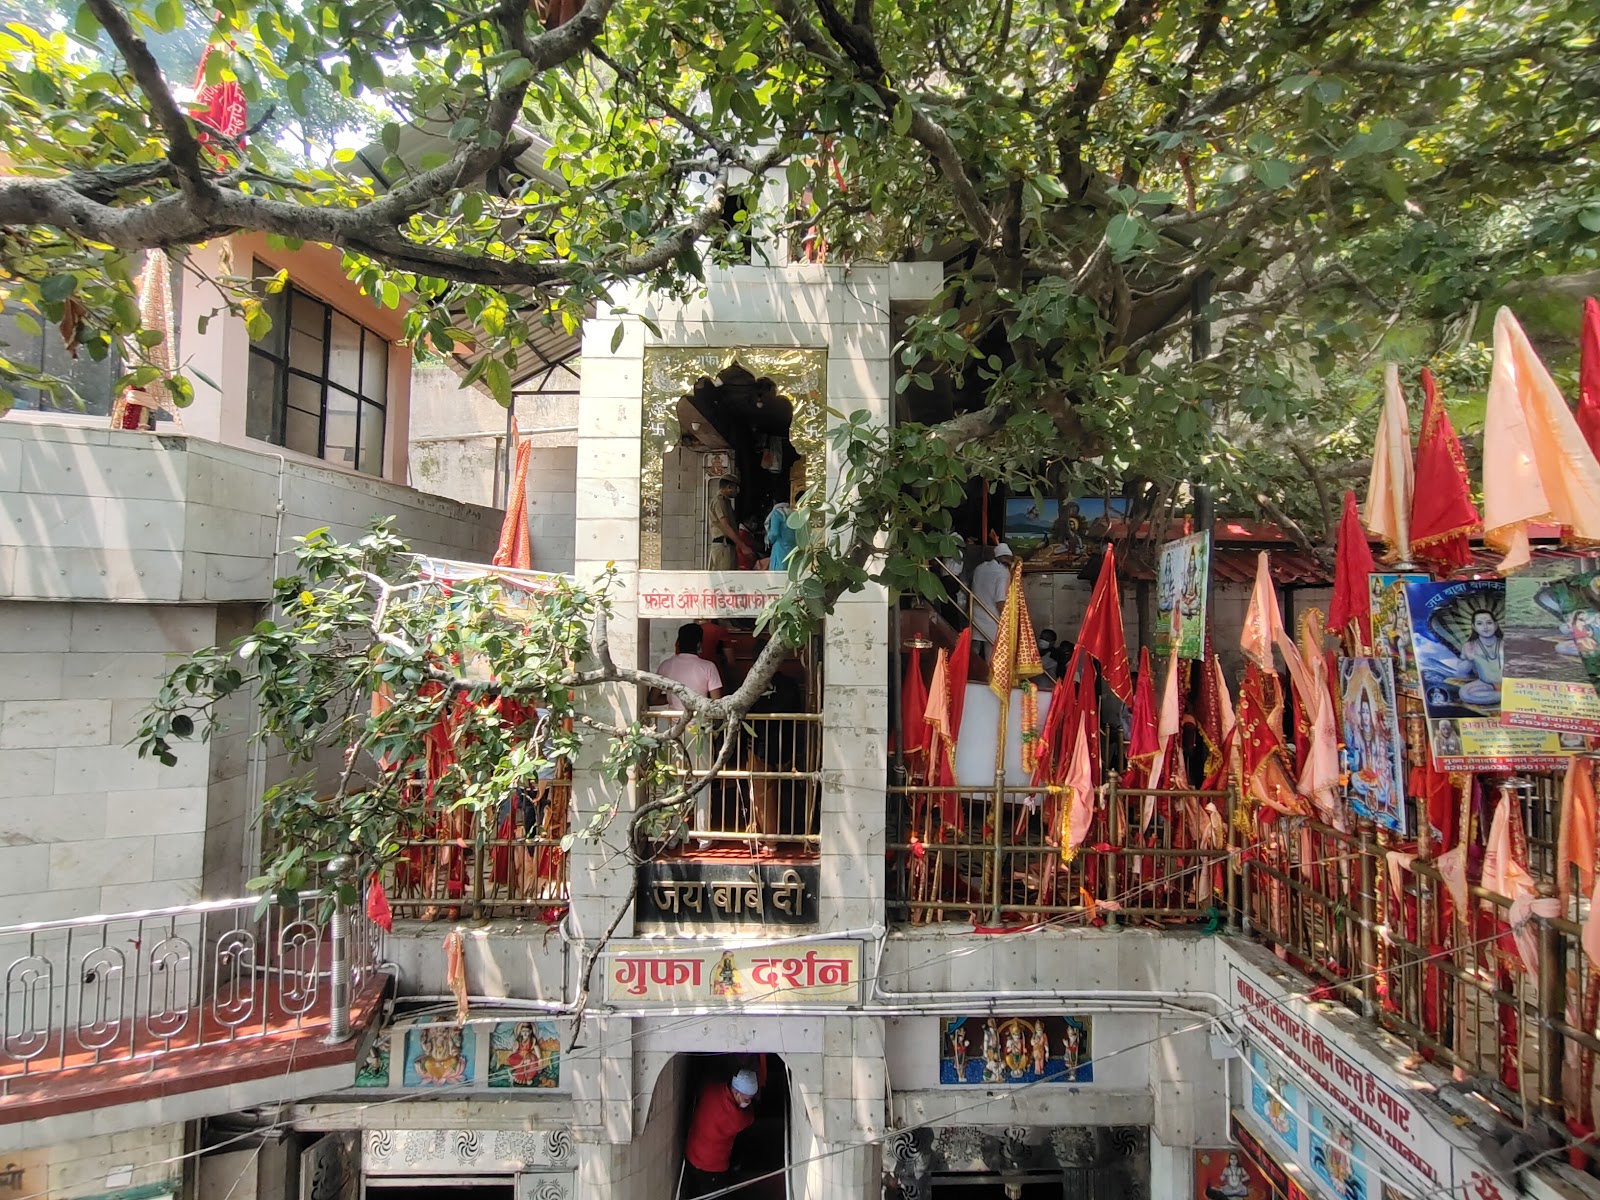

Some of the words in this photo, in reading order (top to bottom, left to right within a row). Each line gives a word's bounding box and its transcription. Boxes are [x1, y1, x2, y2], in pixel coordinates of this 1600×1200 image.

[1424, 593, 1444, 608] जय
[1443, 583, 1467, 597] बाबा
[652, 880, 706, 914] जय
[711, 869, 765, 914] बाबे
[771, 869, 805, 915] दी
[615, 958, 705, 995] गुफा
[751, 951, 853, 989] दर्शन
[1237, 975, 1255, 1006] बाबा
[1269, 1001, 1300, 1043] संसार
[1301, 1023, 1312, 1053] में
[1312, 1034, 1334, 1071] तीन
[1335, 1053, 1365, 1104] वस्तु
